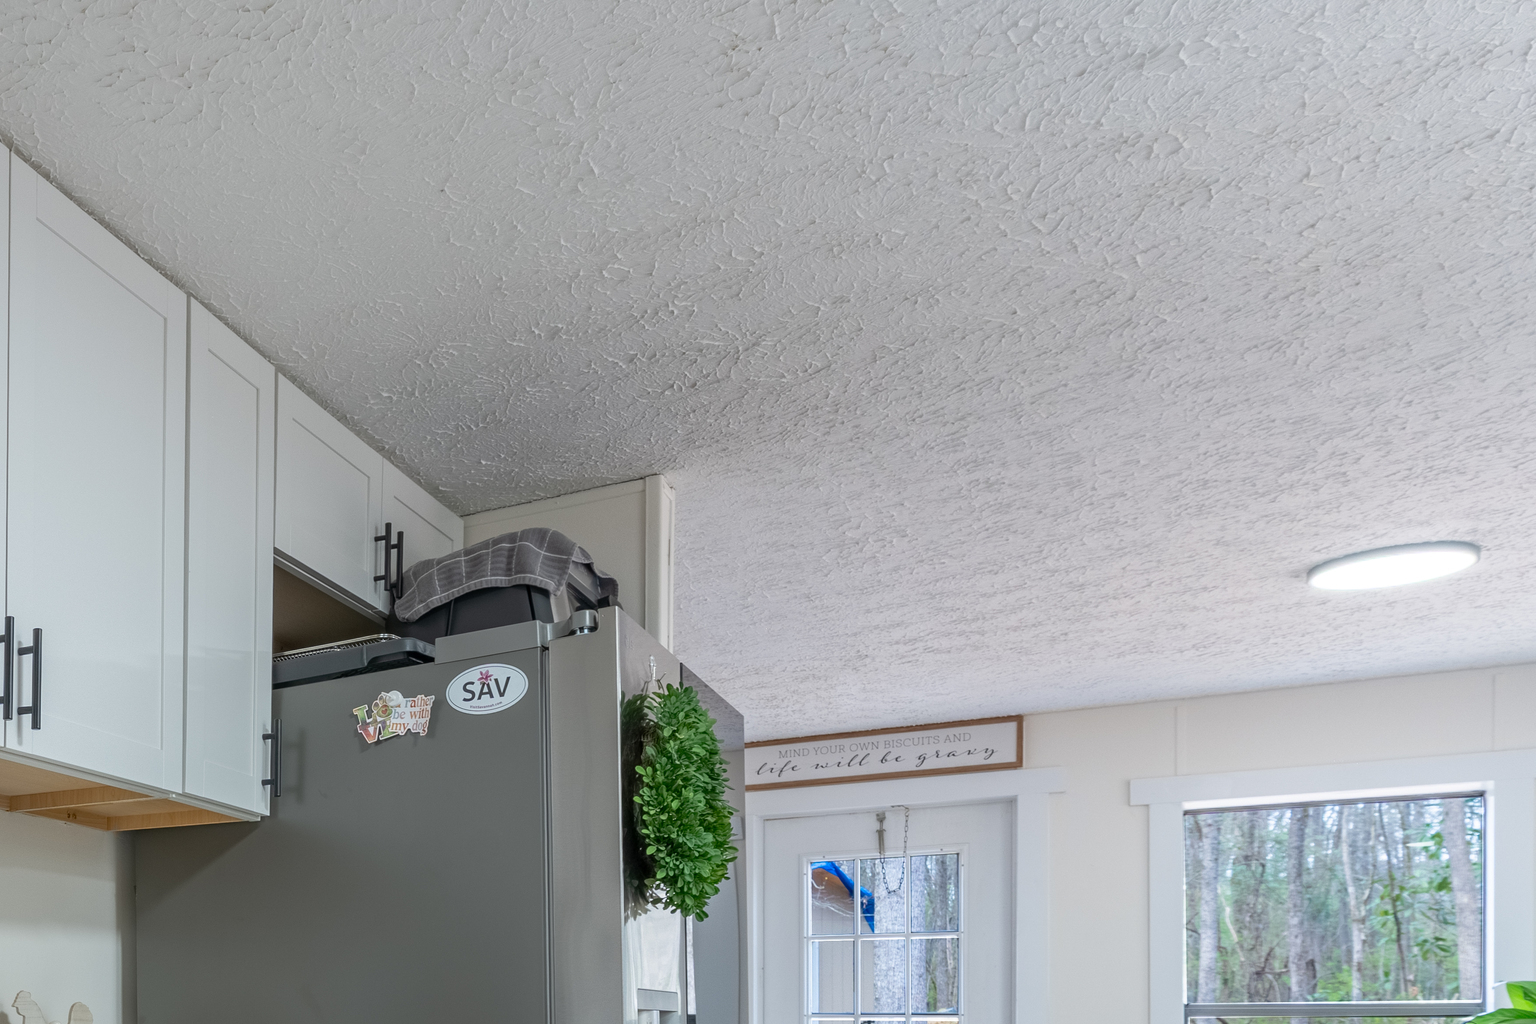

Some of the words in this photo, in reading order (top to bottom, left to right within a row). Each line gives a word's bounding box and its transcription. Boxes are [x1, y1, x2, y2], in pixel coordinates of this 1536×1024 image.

[462, 676, 511, 702] SAV
[405, 694, 434, 708] rather
[392, 708, 405, 720] be
[409, 707, 430, 720] with
[391, 721, 410, 734] my
[412, 719, 428, 735] dog
[778, 748, 810, 759] MIND
[813, 744, 846, 756] YOUR
[849, 741, 880, 751] OWN
[883, 735, 940, 749] BISCUITS
[943, 732, 972, 744] AND
[755, 760, 802, 778] life
[810, 752, 870, 770] will
[878, 751, 905, 764] be
[915, 747, 998, 768] gravy
